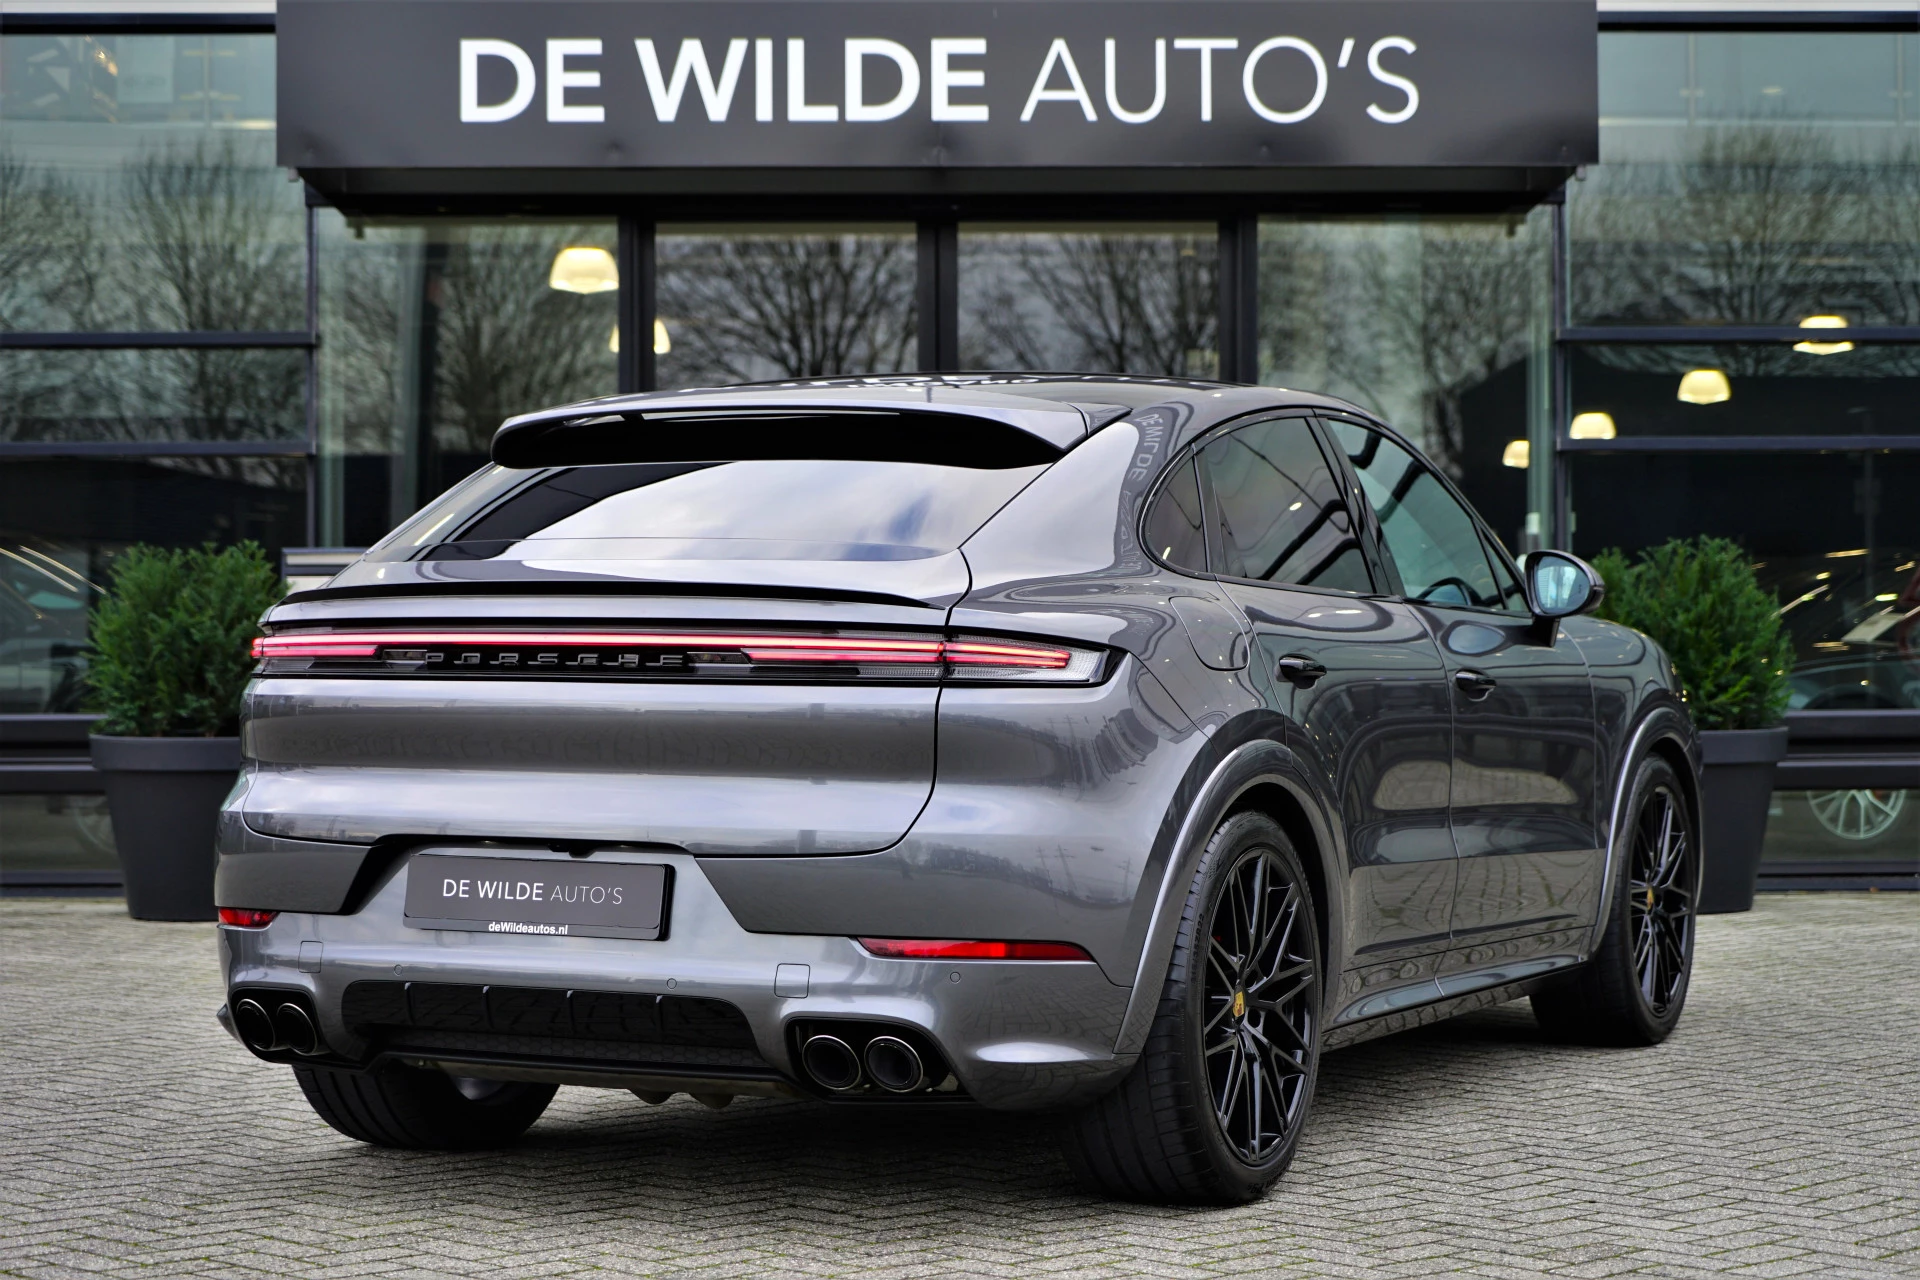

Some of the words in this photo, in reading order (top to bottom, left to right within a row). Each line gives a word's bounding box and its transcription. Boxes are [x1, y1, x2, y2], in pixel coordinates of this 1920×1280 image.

[459, 38, 605, 124] DE
[634, 37, 990, 124] WILDE
[1019, 36, 1420, 125] AUTO'S
[424, 652, 684, 668] PORSCHE
[442, 878, 471, 899] DE
[478, 880, 545, 902] WILDE
[550, 884, 624, 906] AUTO'S
[488, 921, 570, 936] deWildeautos.nl
